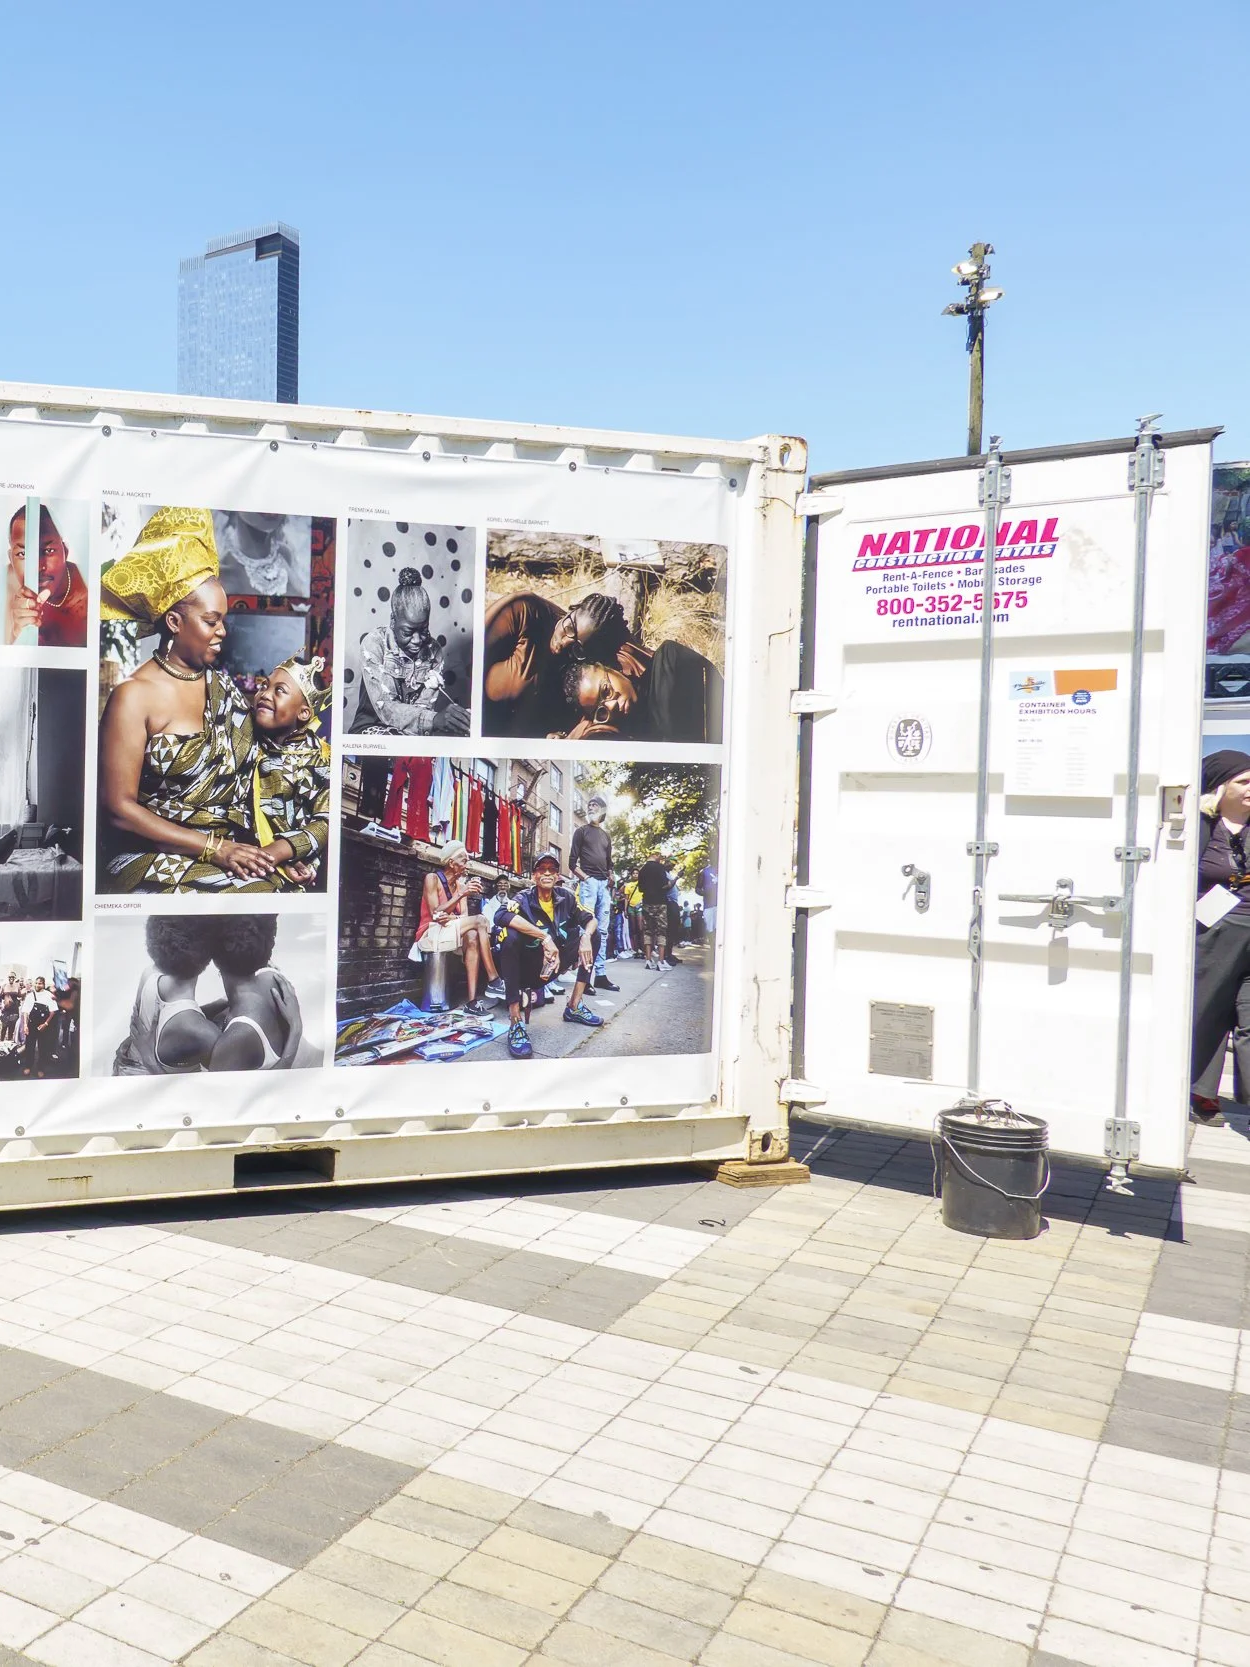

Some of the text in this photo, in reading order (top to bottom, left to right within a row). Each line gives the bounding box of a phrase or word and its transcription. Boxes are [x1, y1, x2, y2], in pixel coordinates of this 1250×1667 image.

[854, 550, 976, 569] CONSTRUCTION
[882, 570, 953, 581] Rent-A-Fence
[866, 576, 1041, 594] Portable Toilets Mobi Storage
